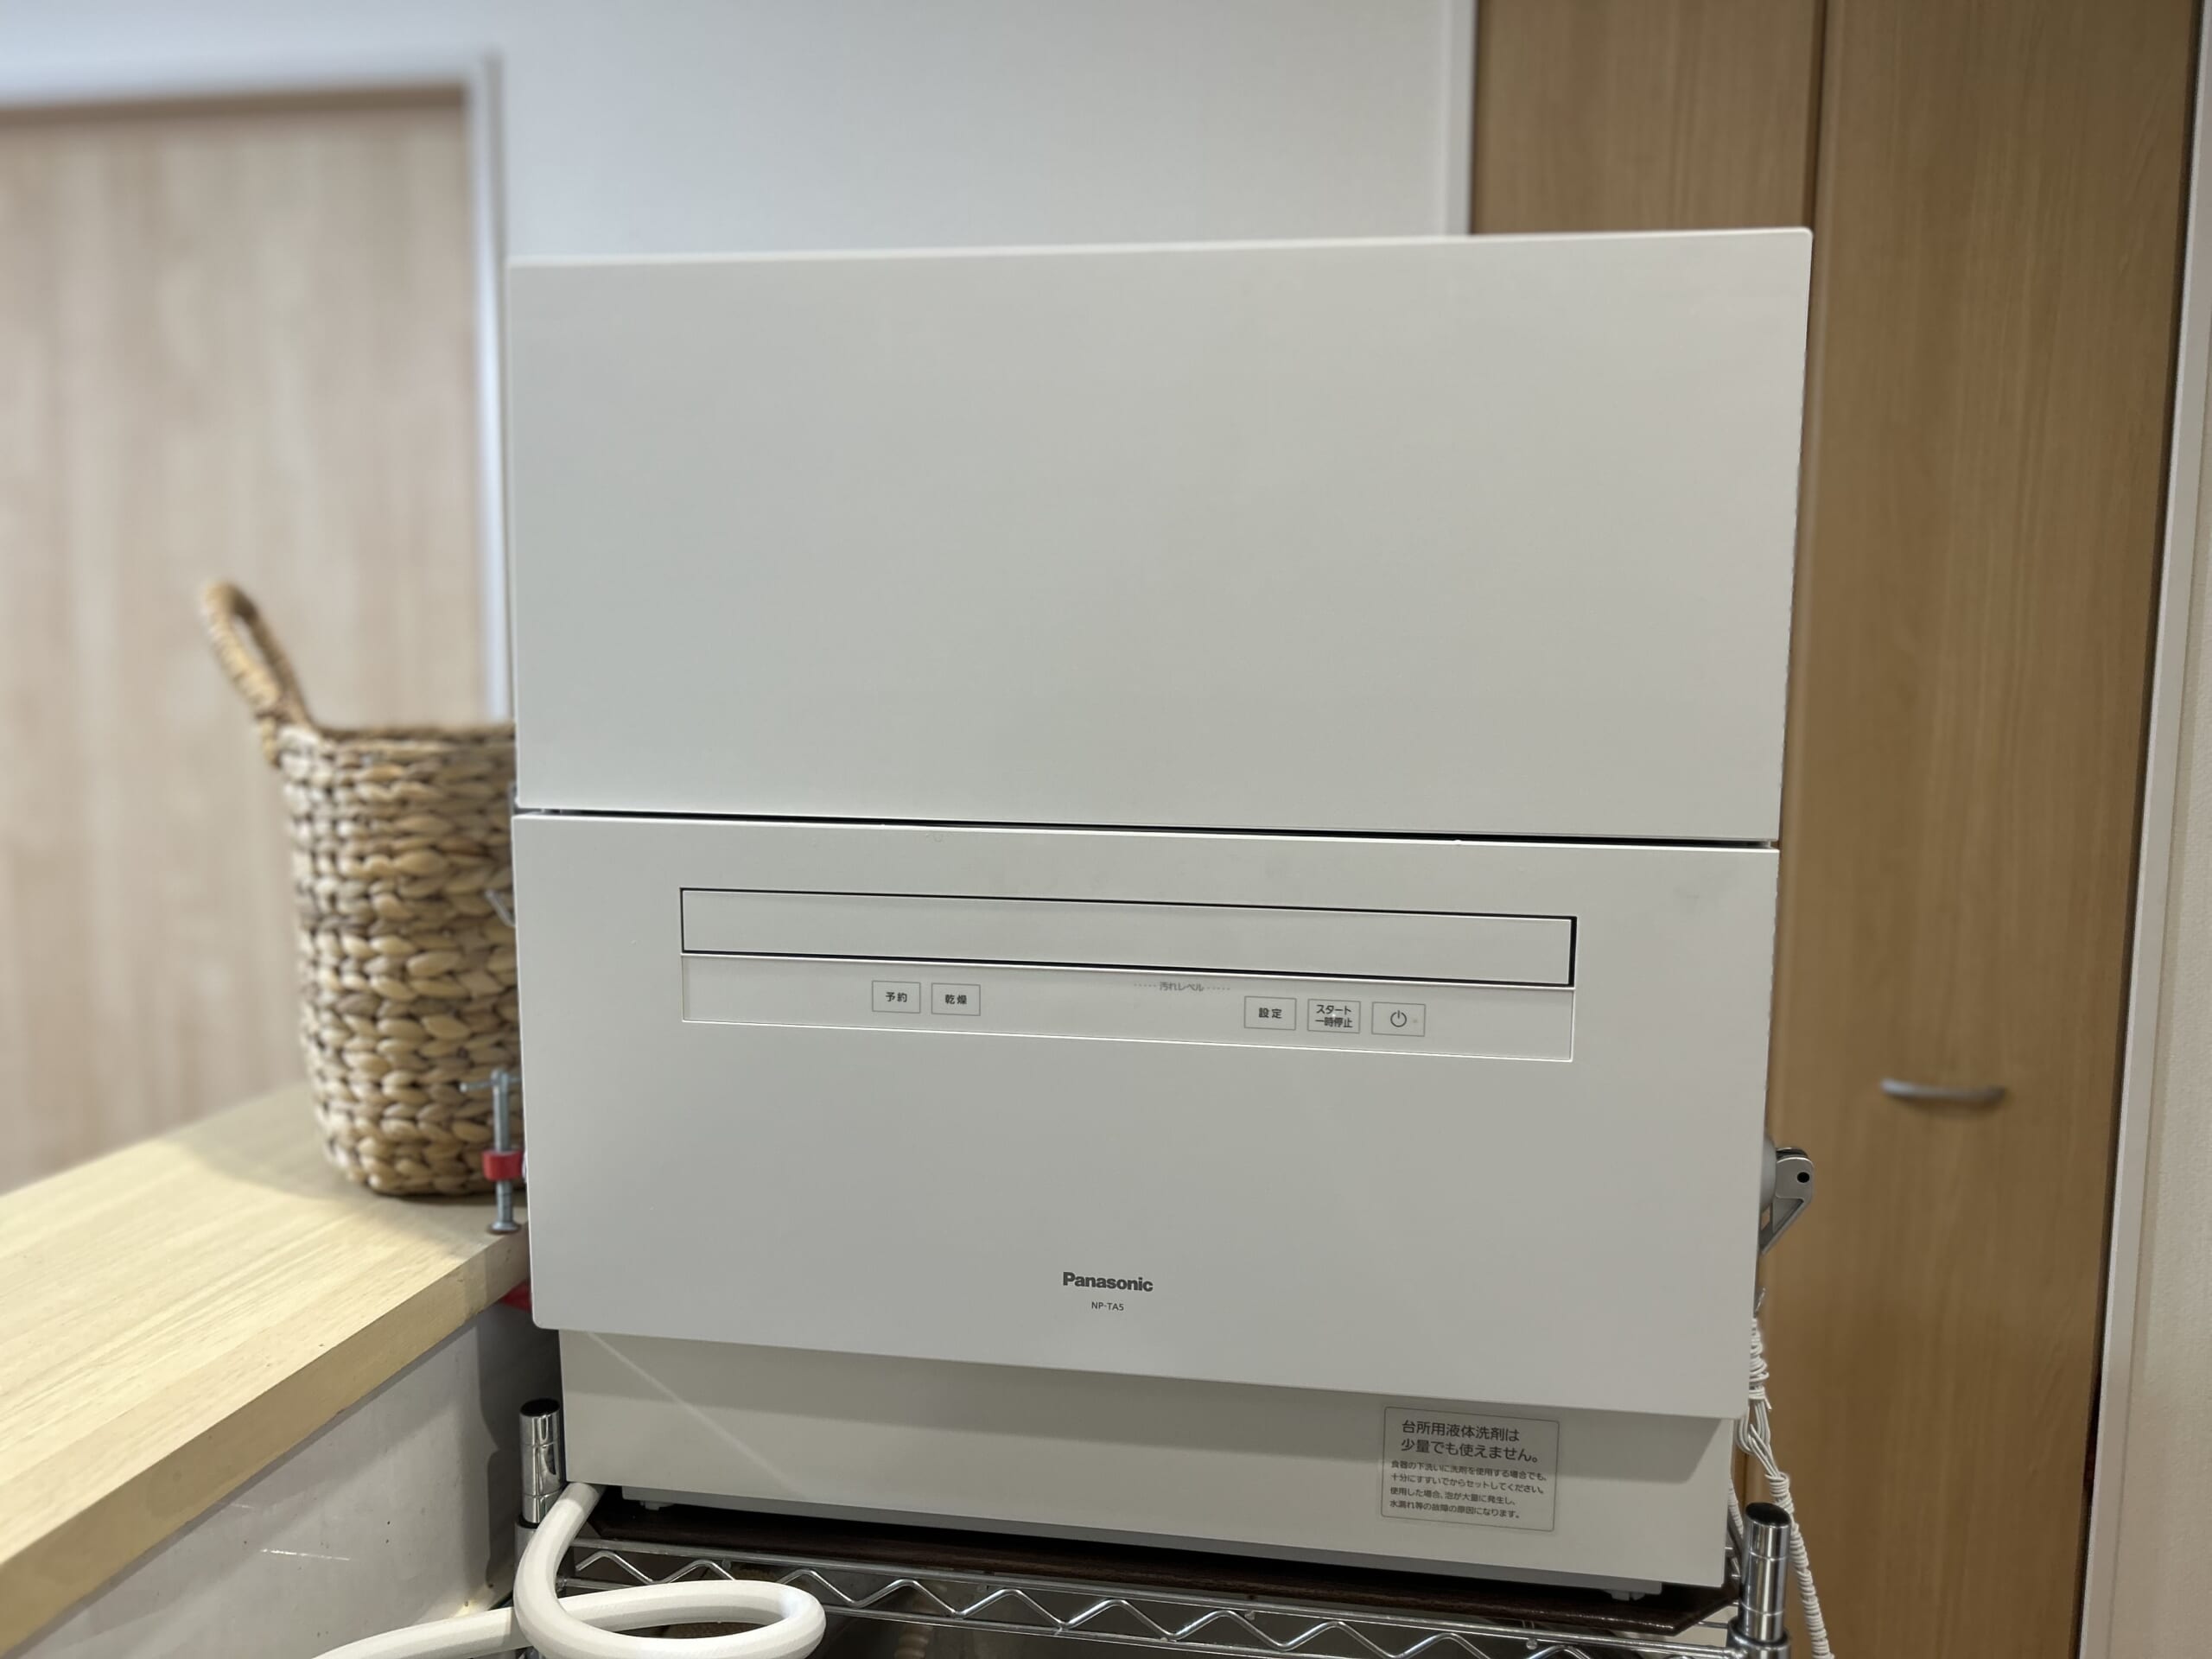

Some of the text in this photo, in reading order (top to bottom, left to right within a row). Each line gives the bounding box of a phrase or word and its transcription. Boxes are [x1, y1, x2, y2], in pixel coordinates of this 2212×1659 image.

[1159, 982, 1205, 992] 汚れレベル
[886, 992, 907, 1002] 予約
[944, 994, 968, 1005] 乾燥
[1258, 1007, 1282, 1019] 設定
[1316, 1004, 1351, 1015] スタート
[1315, 1017, 1353, 1028] 一時停止
[1063, 1271, 1154, 1292] Panasonic
[1091, 1301, 1124, 1311] NP-TA5
[1402, 1419, 1520, 1442] 台所用液体洗剤は
[1401, 1438, 1538, 1463] 少量でも使えません。
